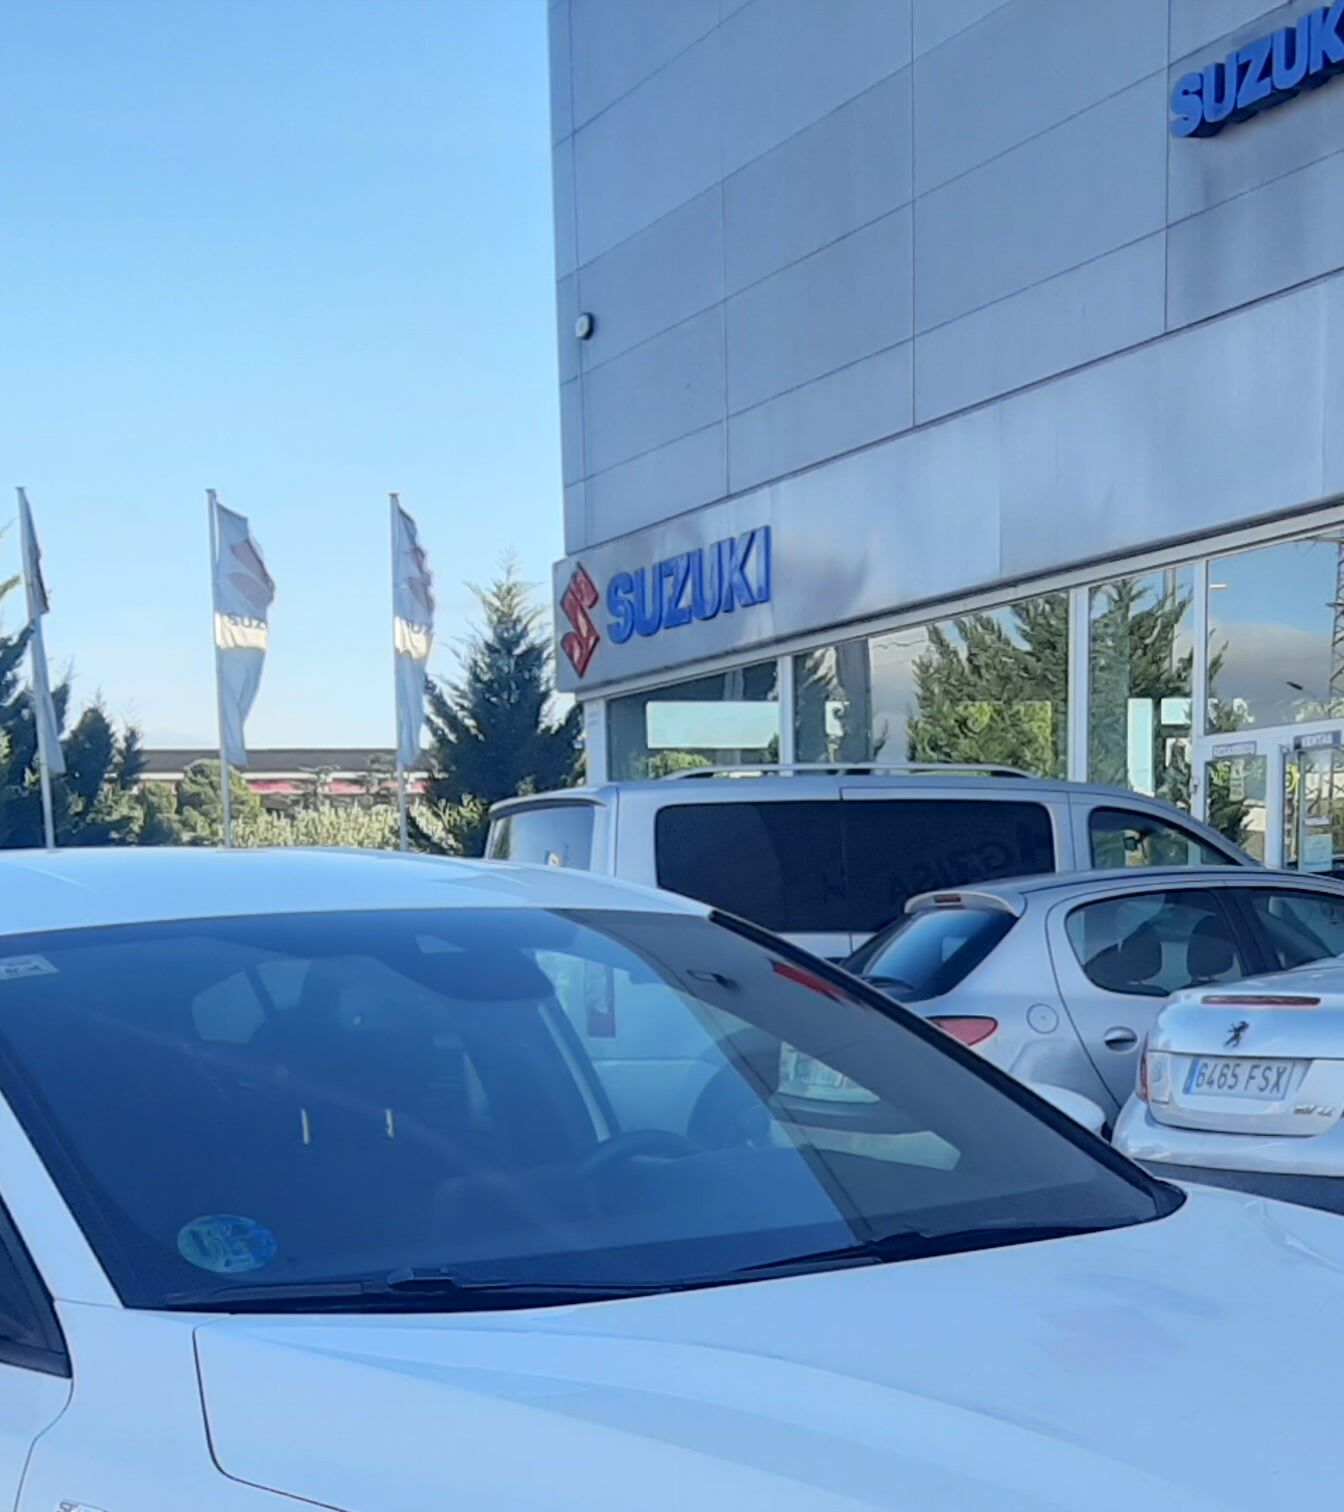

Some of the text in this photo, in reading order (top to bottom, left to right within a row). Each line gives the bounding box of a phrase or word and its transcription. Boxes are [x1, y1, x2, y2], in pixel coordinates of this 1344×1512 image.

[607, 534, 772, 644] SUZUKI
[1195, 1062, 1288, 1094] 6465 FSX
